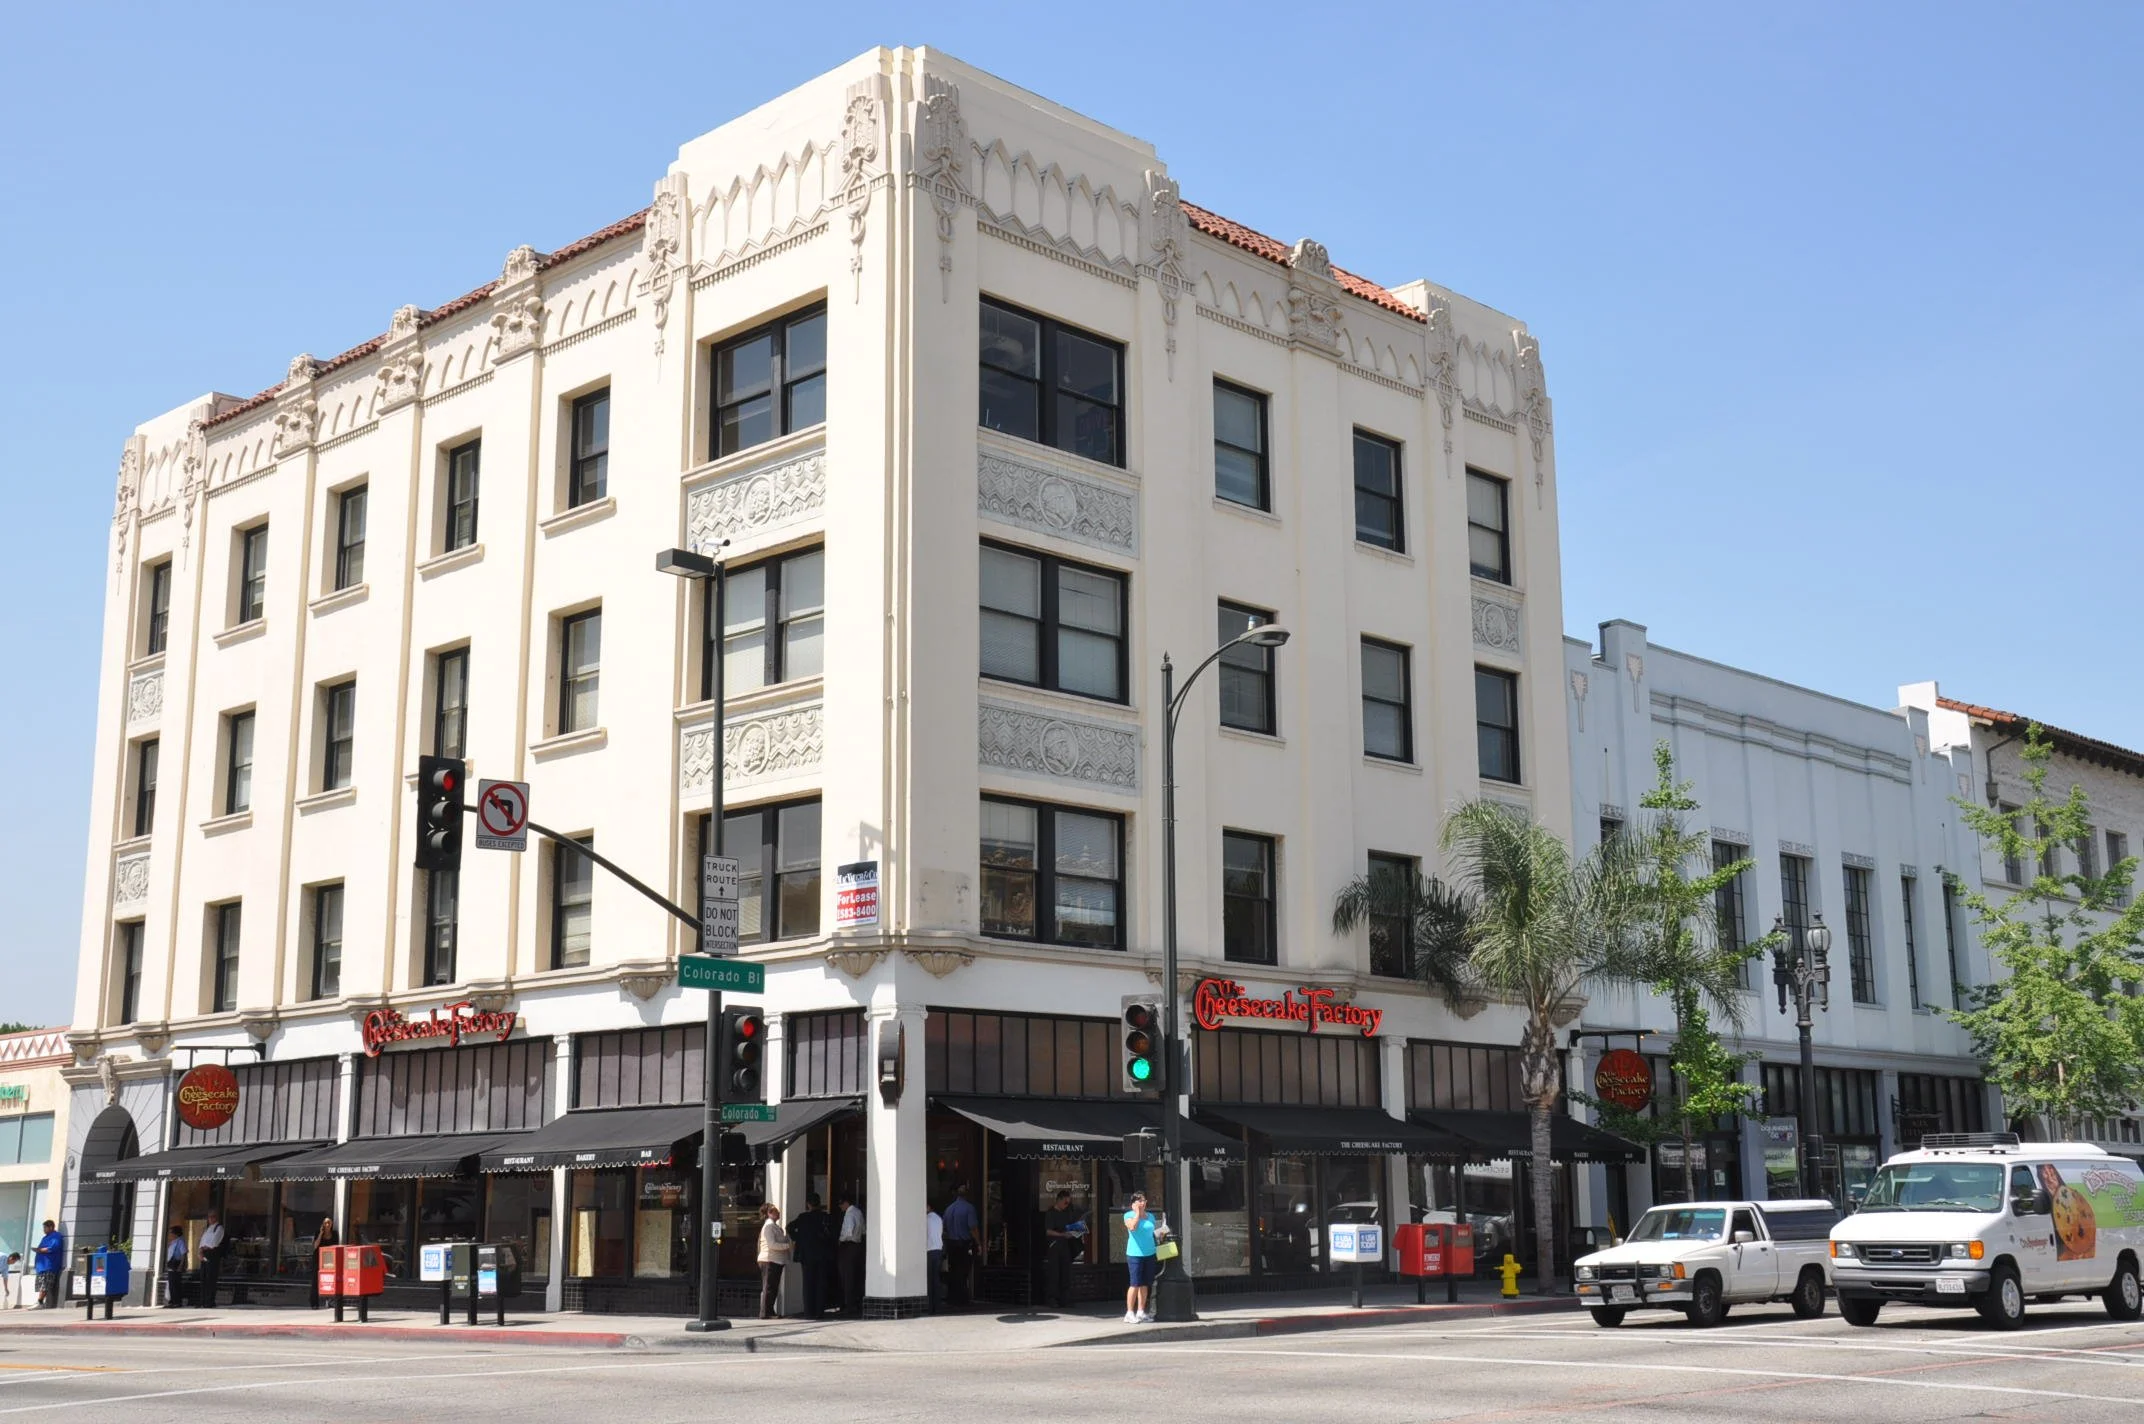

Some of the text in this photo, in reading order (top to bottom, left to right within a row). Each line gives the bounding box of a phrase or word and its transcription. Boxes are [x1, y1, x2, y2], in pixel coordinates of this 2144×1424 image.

[706, 861, 737, 872] TRUCK
[706, 874, 737, 886] ROUTE
[705, 906, 737, 921] DO NOT
[705, 925, 737, 938] BLOCK
[705, 939, 737, 951] INTERSECTION
[683, 965, 740, 983] Colorado
[1194, 978, 1382, 1037] Cheesecake Factory
[362, 1000, 517, 1058] Cheesecake Factory
[180, 1086, 237, 1105] Cheesecake
[191, 1098, 236, 1116] Factory
[722, 1106, 759, 1120] Colorado
[1043, 1143, 1225, 1155] RESTAURANT BAR
